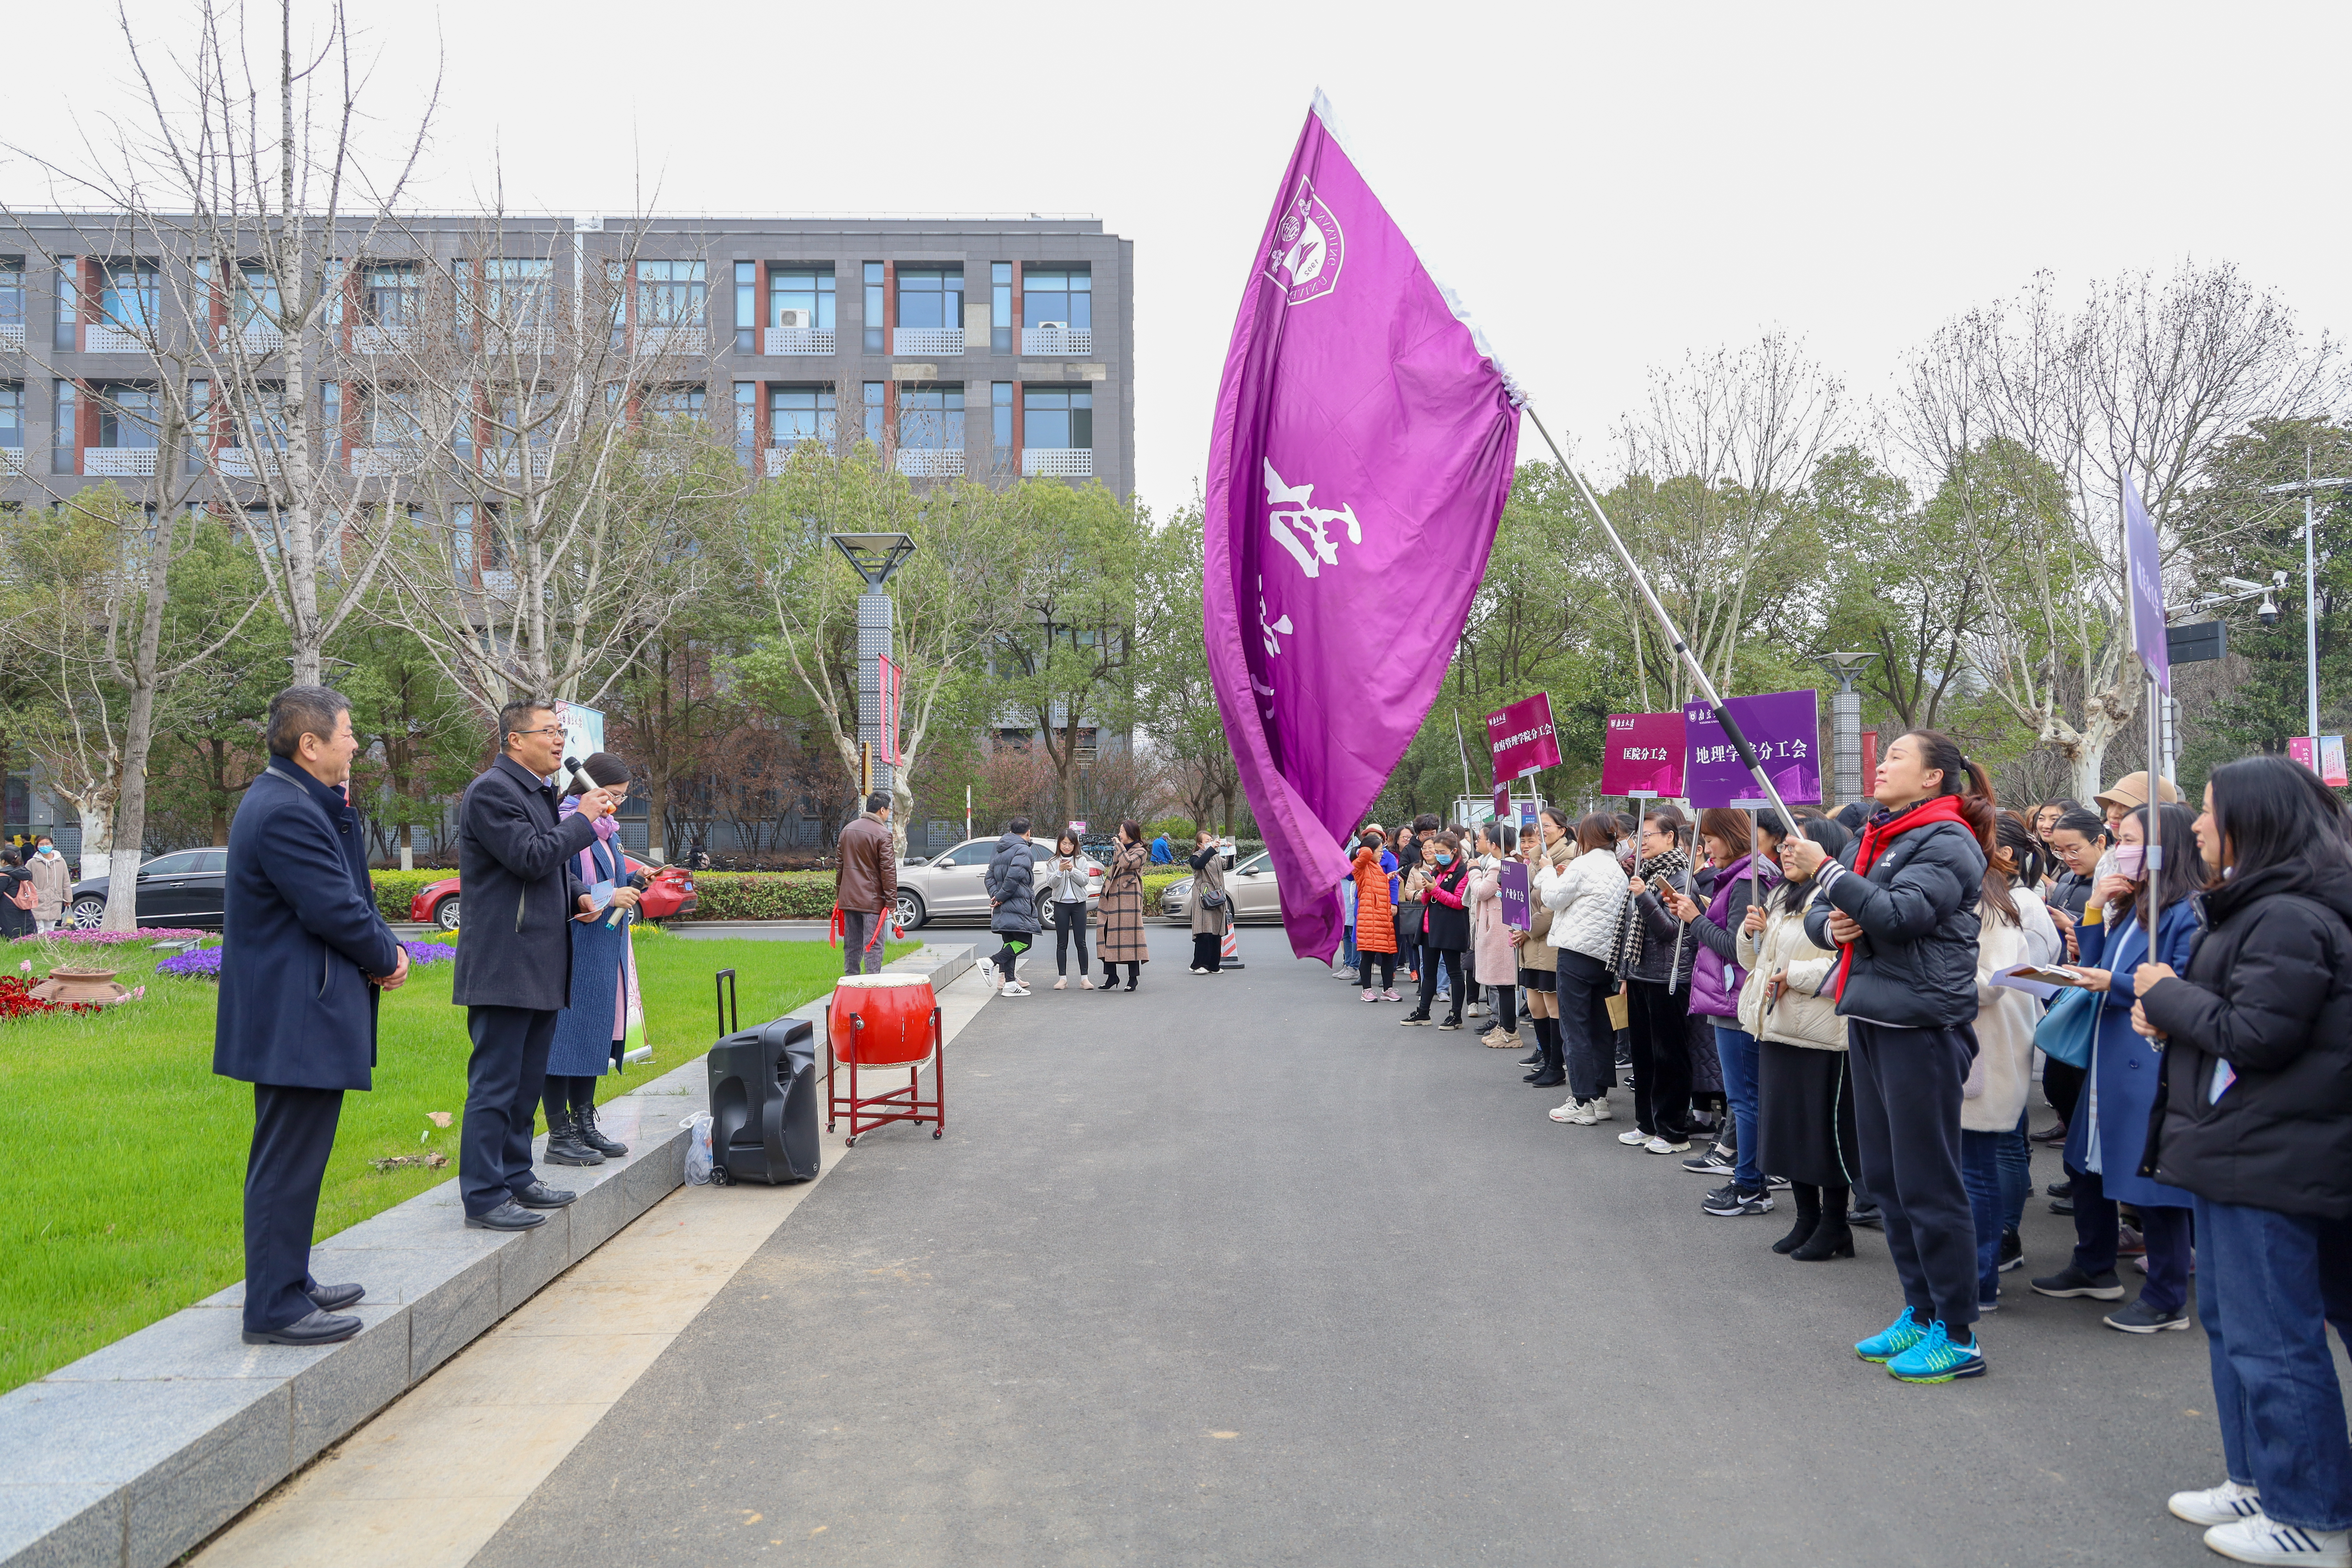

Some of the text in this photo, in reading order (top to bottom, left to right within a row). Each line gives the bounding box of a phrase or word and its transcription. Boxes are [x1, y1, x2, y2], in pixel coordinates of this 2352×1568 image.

[1493, 723, 1552, 753] 政府管理学院分工会
